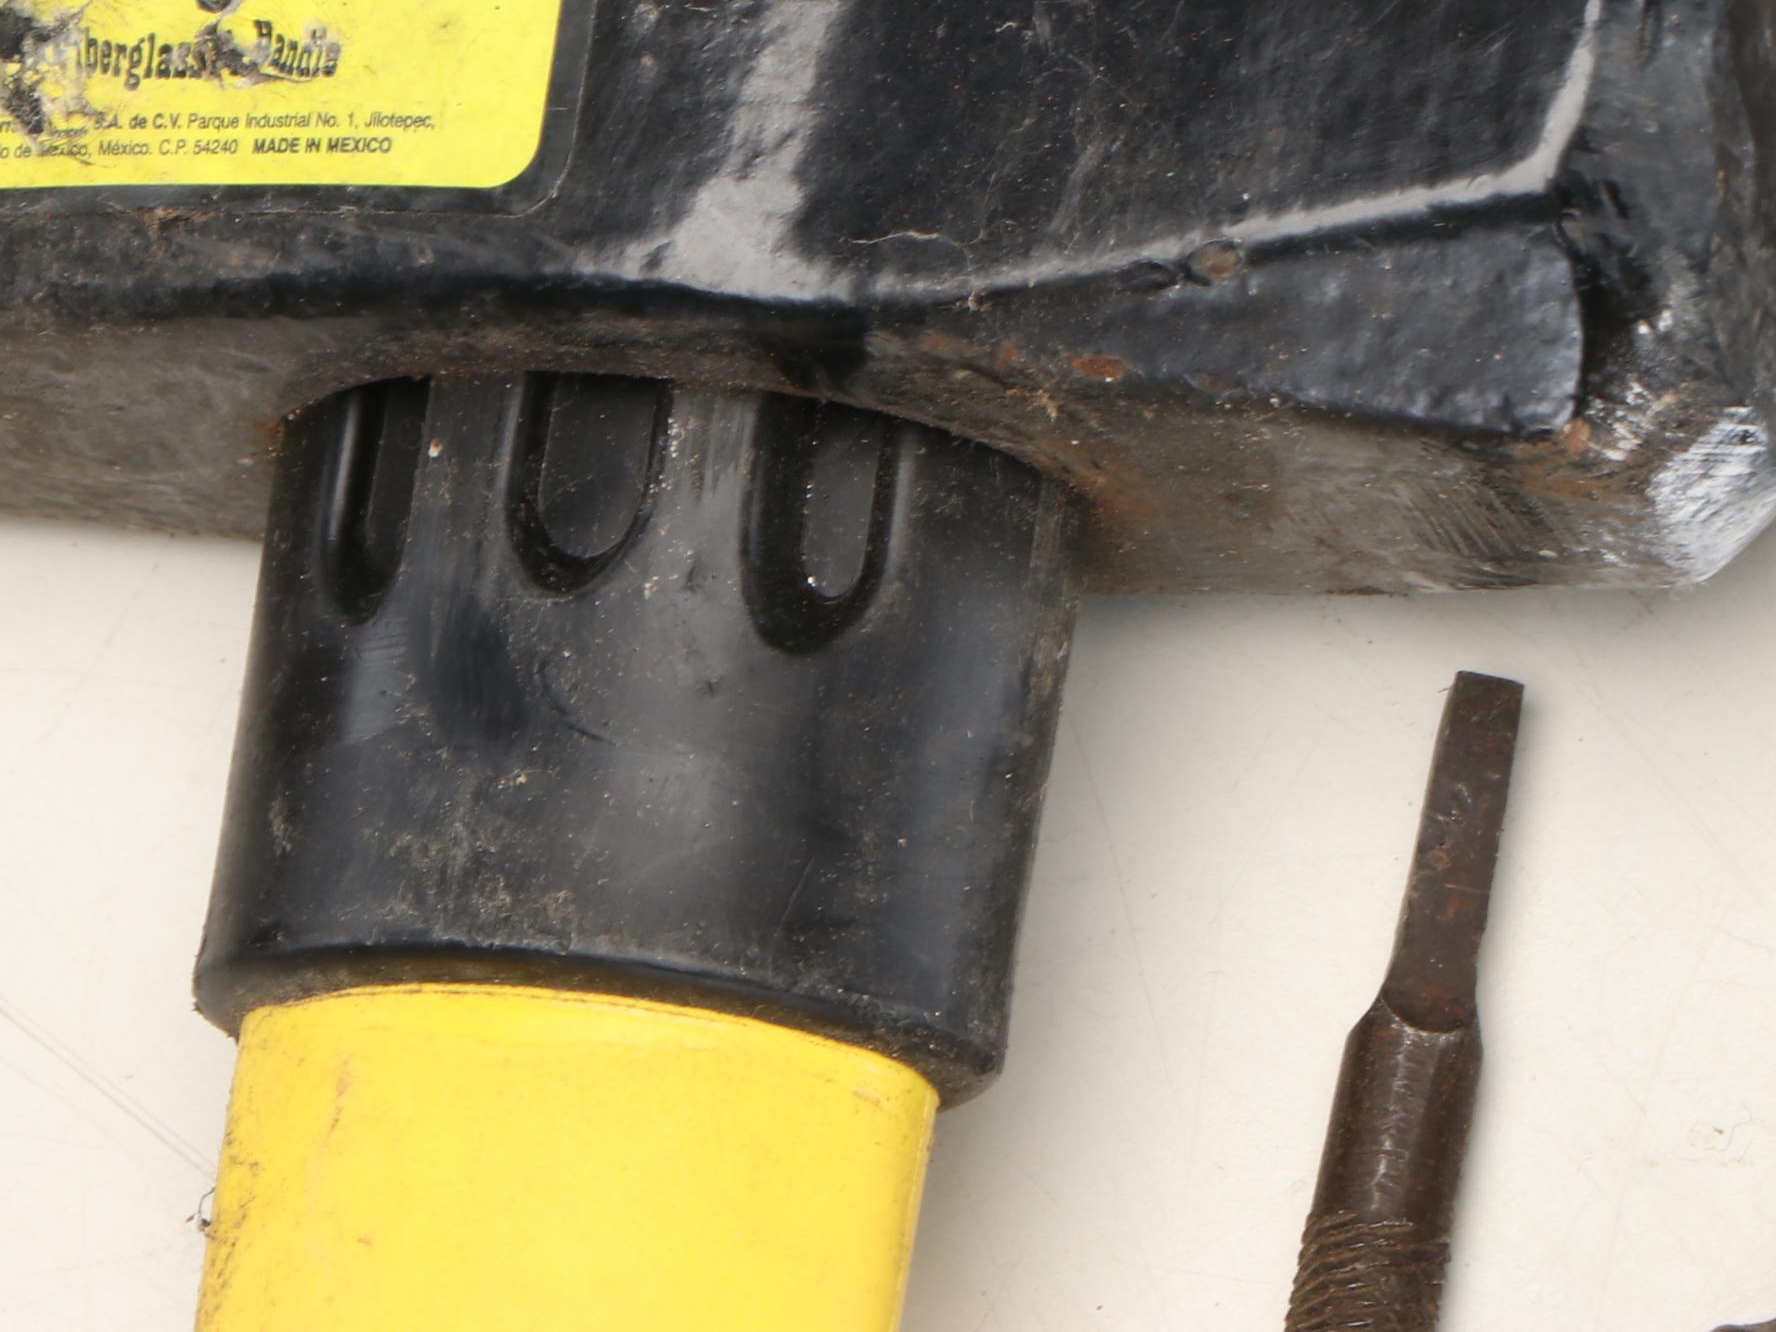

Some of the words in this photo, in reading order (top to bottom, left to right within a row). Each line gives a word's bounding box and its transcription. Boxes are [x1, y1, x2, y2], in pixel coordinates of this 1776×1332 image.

[128, 113, 148, 129] de
[152, 112, 182, 129] C.V.
[187, 112, 240, 131] Parque
[245, 112, 310, 130] Industrial
[315, 112, 340, 127] No.
[363, 111, 436, 133] Jilotepec,
[14, 143, 33, 158] de
[97, 140, 153, 157] México.
[158, 138, 188, 156] C.P.
[193, 138, 239, 155] 54240
[252, 137, 301, 154] MADE
[304, 137, 322, 152] IN
[326, 136, 393, 153] MEXICO
